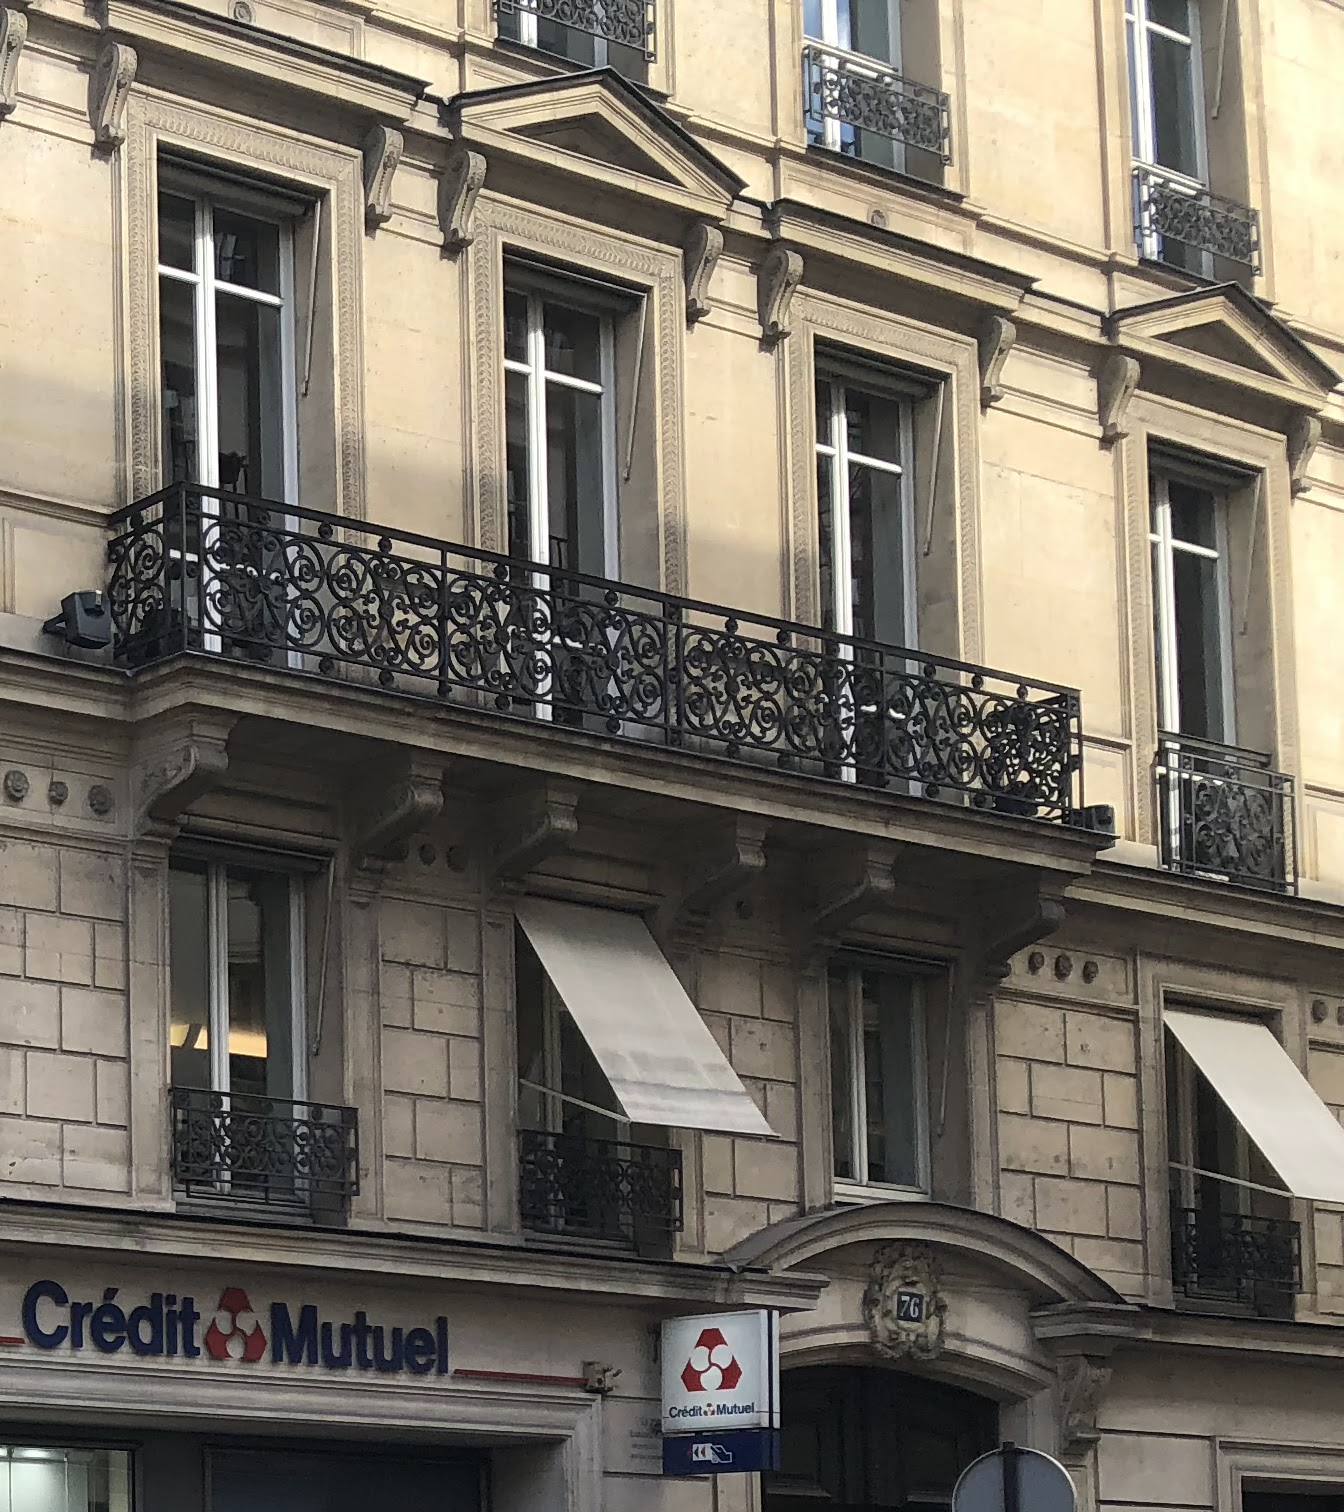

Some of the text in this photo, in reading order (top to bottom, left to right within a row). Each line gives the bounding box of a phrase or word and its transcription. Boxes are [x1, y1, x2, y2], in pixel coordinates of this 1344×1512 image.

[899, 1295, 920, 1318] 76
[21, 1280, 449, 1375] Crédit Mutuel
[668, 1401, 755, 1419] Crédit Mutuel
